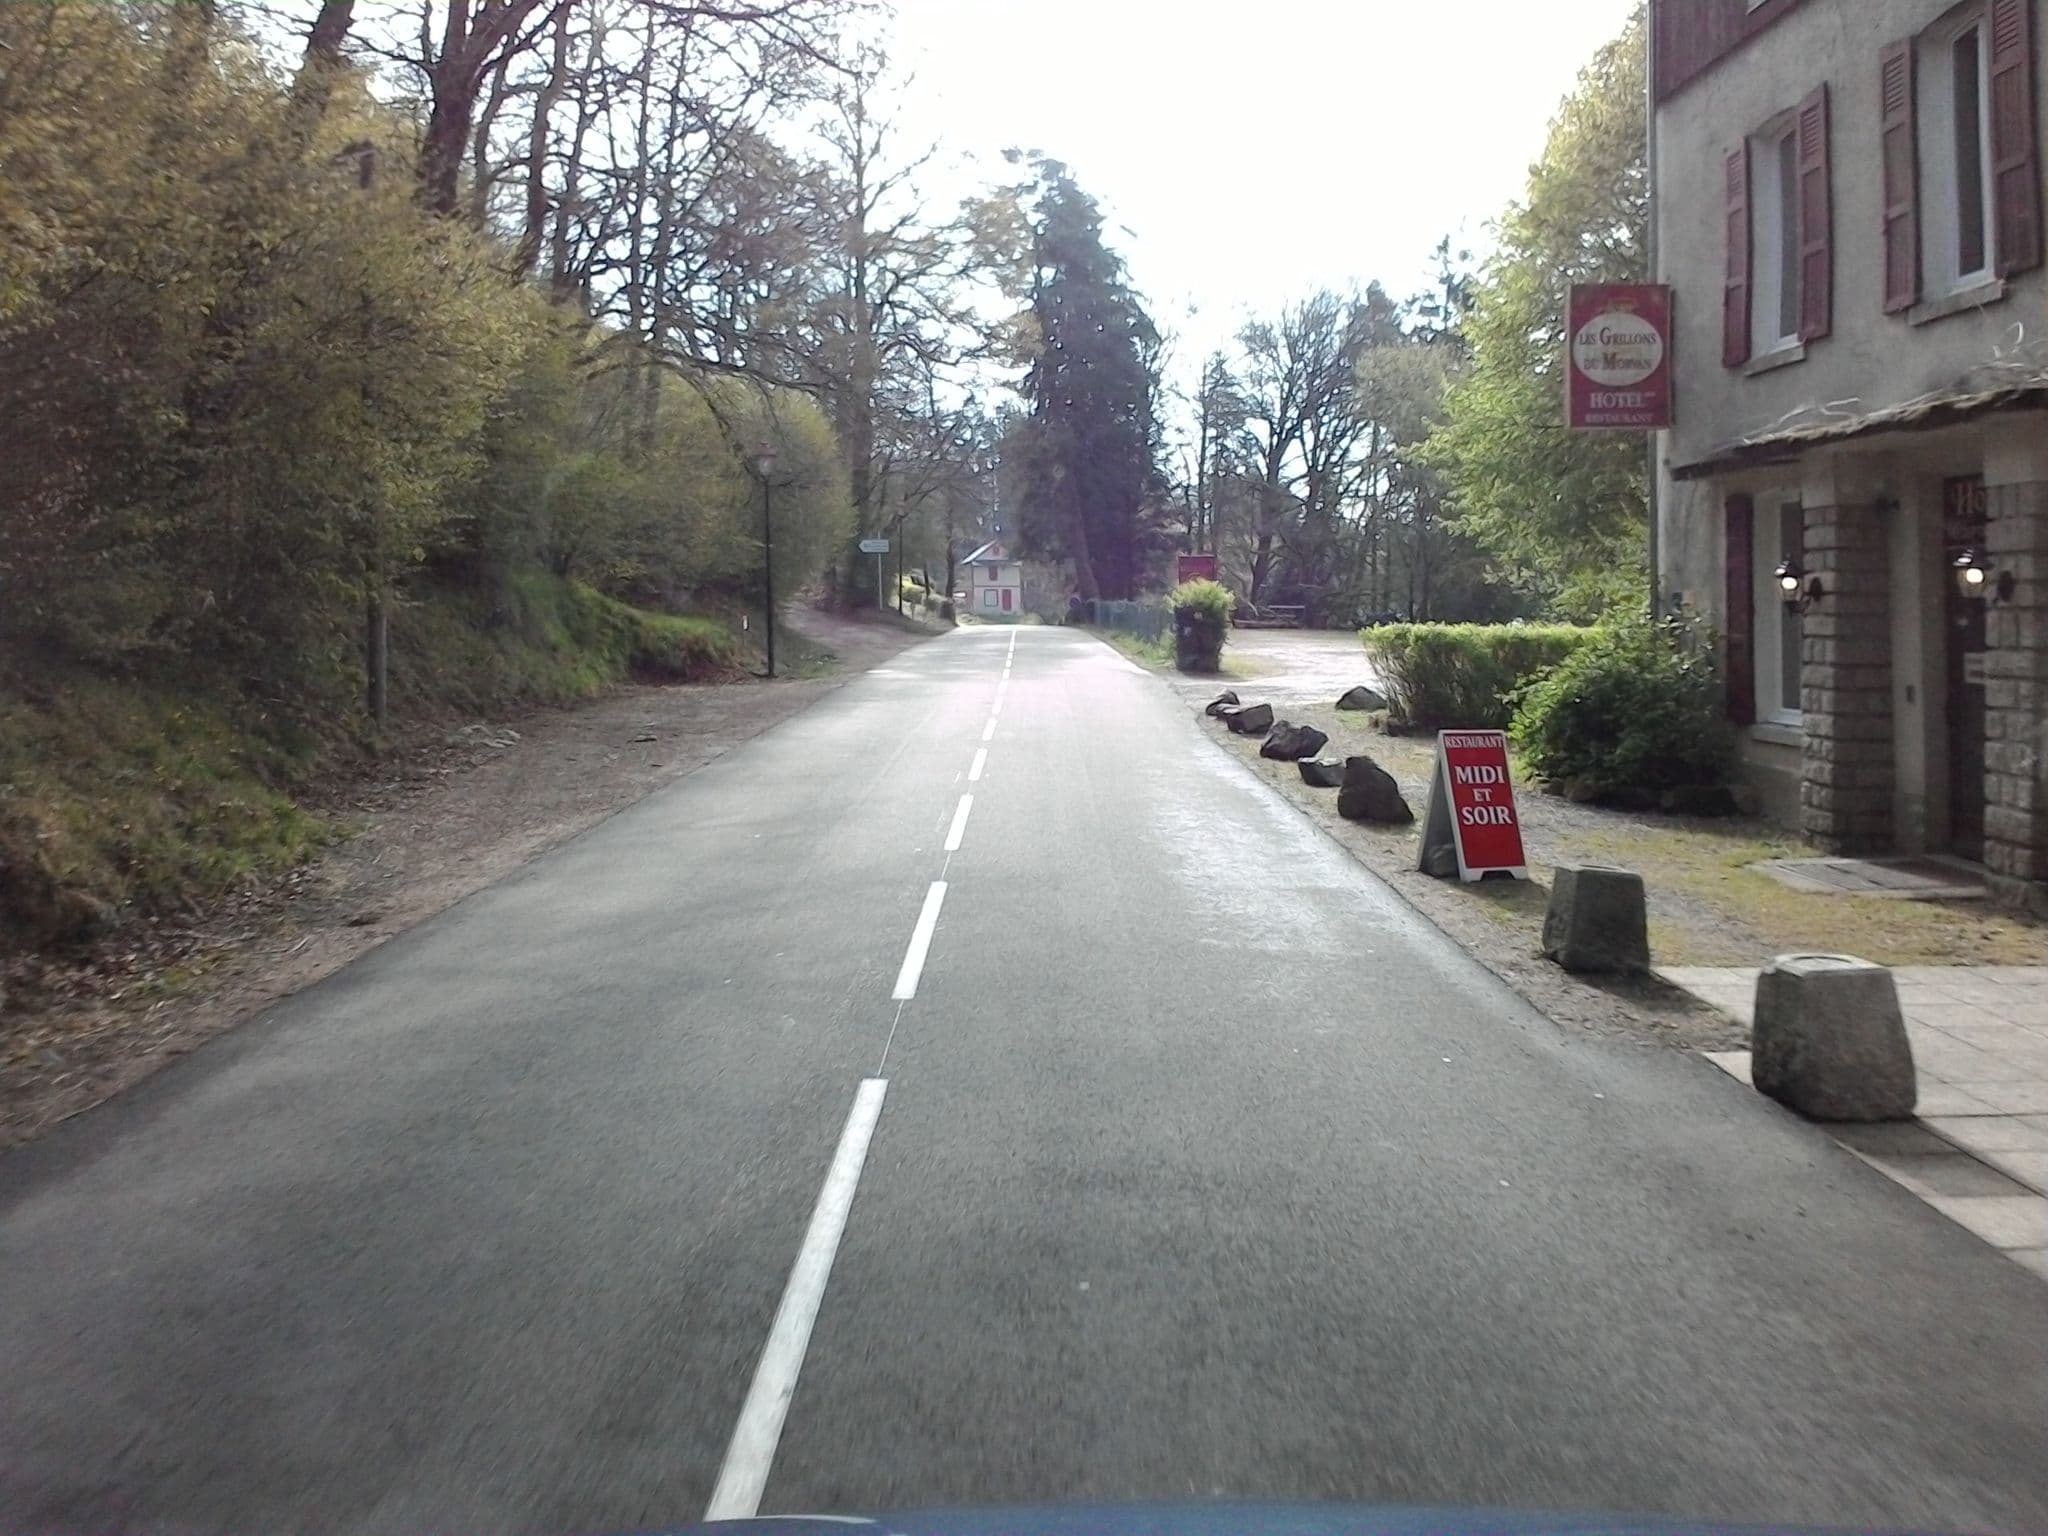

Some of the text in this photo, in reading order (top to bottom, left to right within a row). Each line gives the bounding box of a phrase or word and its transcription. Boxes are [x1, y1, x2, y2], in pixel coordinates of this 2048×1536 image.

[1579, 326, 1656, 345] LES GRILLONS
[1589, 391, 1648, 409] HOTEL
[1445, 735, 1503, 748] RESTAURANT
[1454, 765, 1505, 784] MIDI
[1472, 788, 1493, 802] ET
[1461, 806, 1513, 825] SOIR
